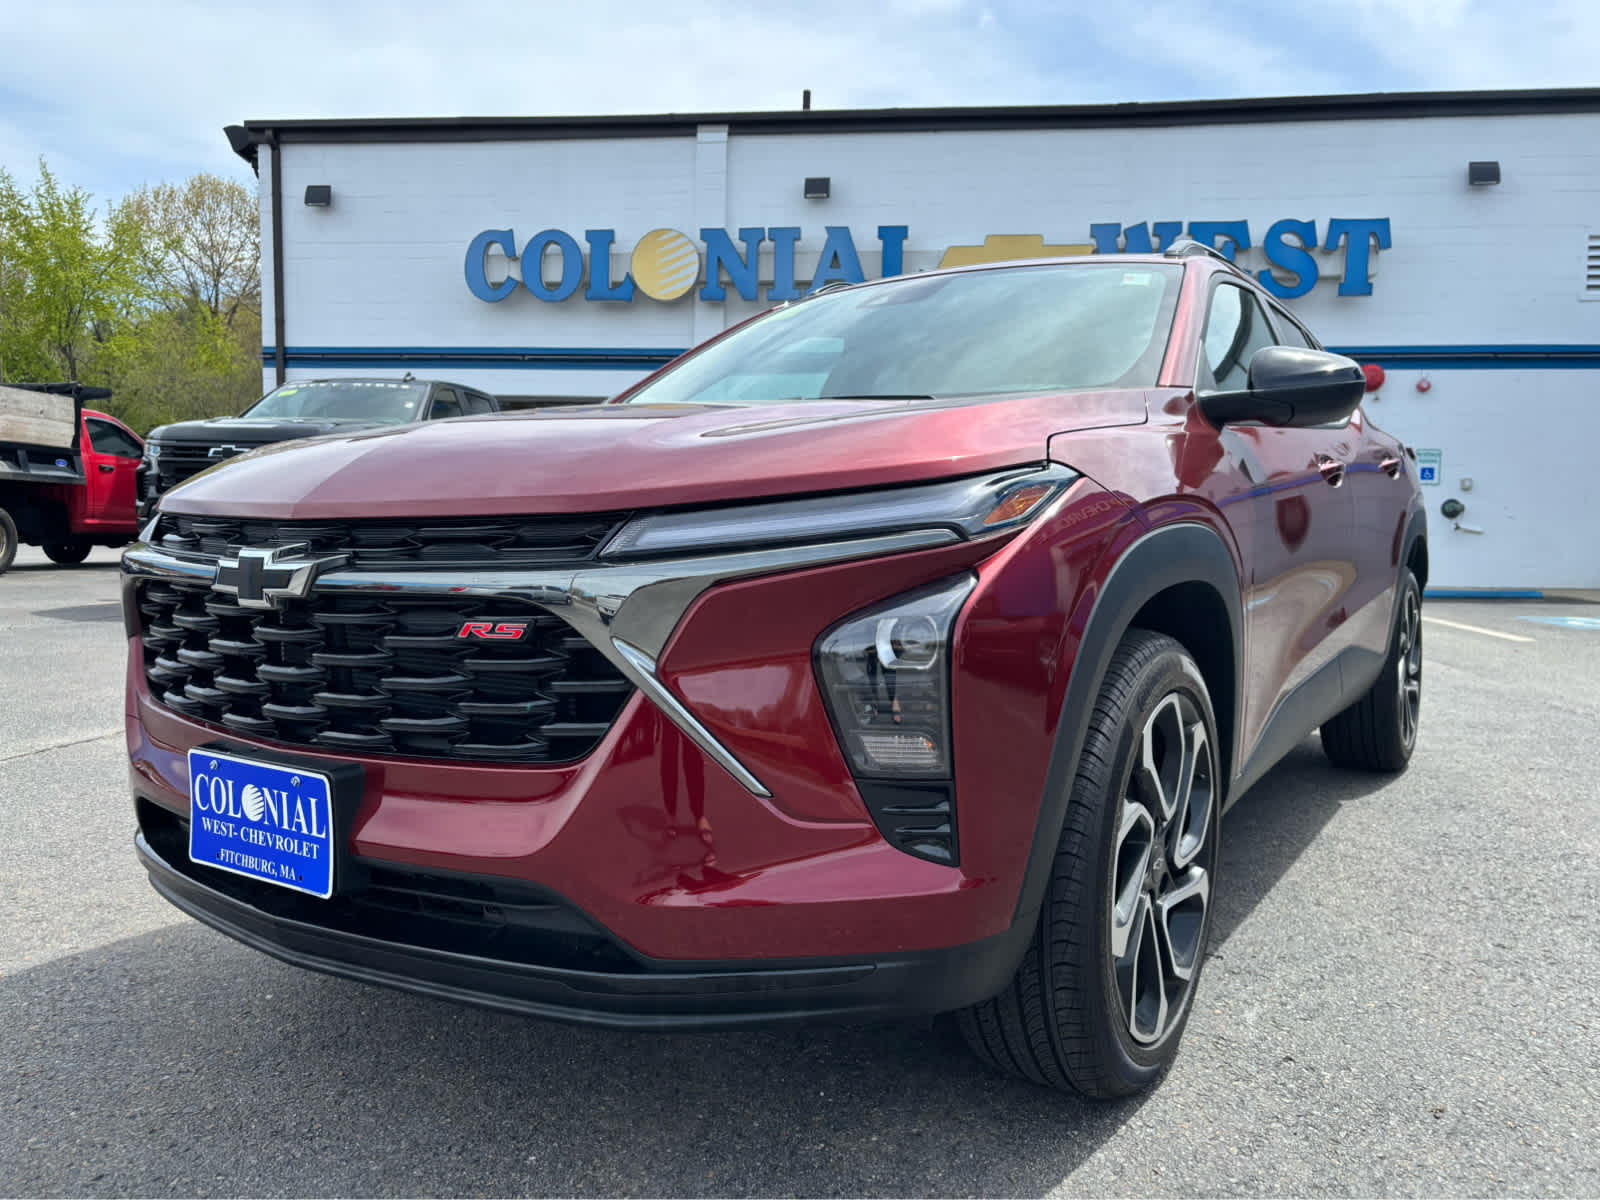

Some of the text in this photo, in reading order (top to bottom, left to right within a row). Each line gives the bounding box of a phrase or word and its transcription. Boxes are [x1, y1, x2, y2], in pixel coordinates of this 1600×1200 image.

[458, 622, 527, 639] RS
[195, 773, 327, 839] COLONIAL
[220, 848, 297, 881] FITCHBURG, MA
